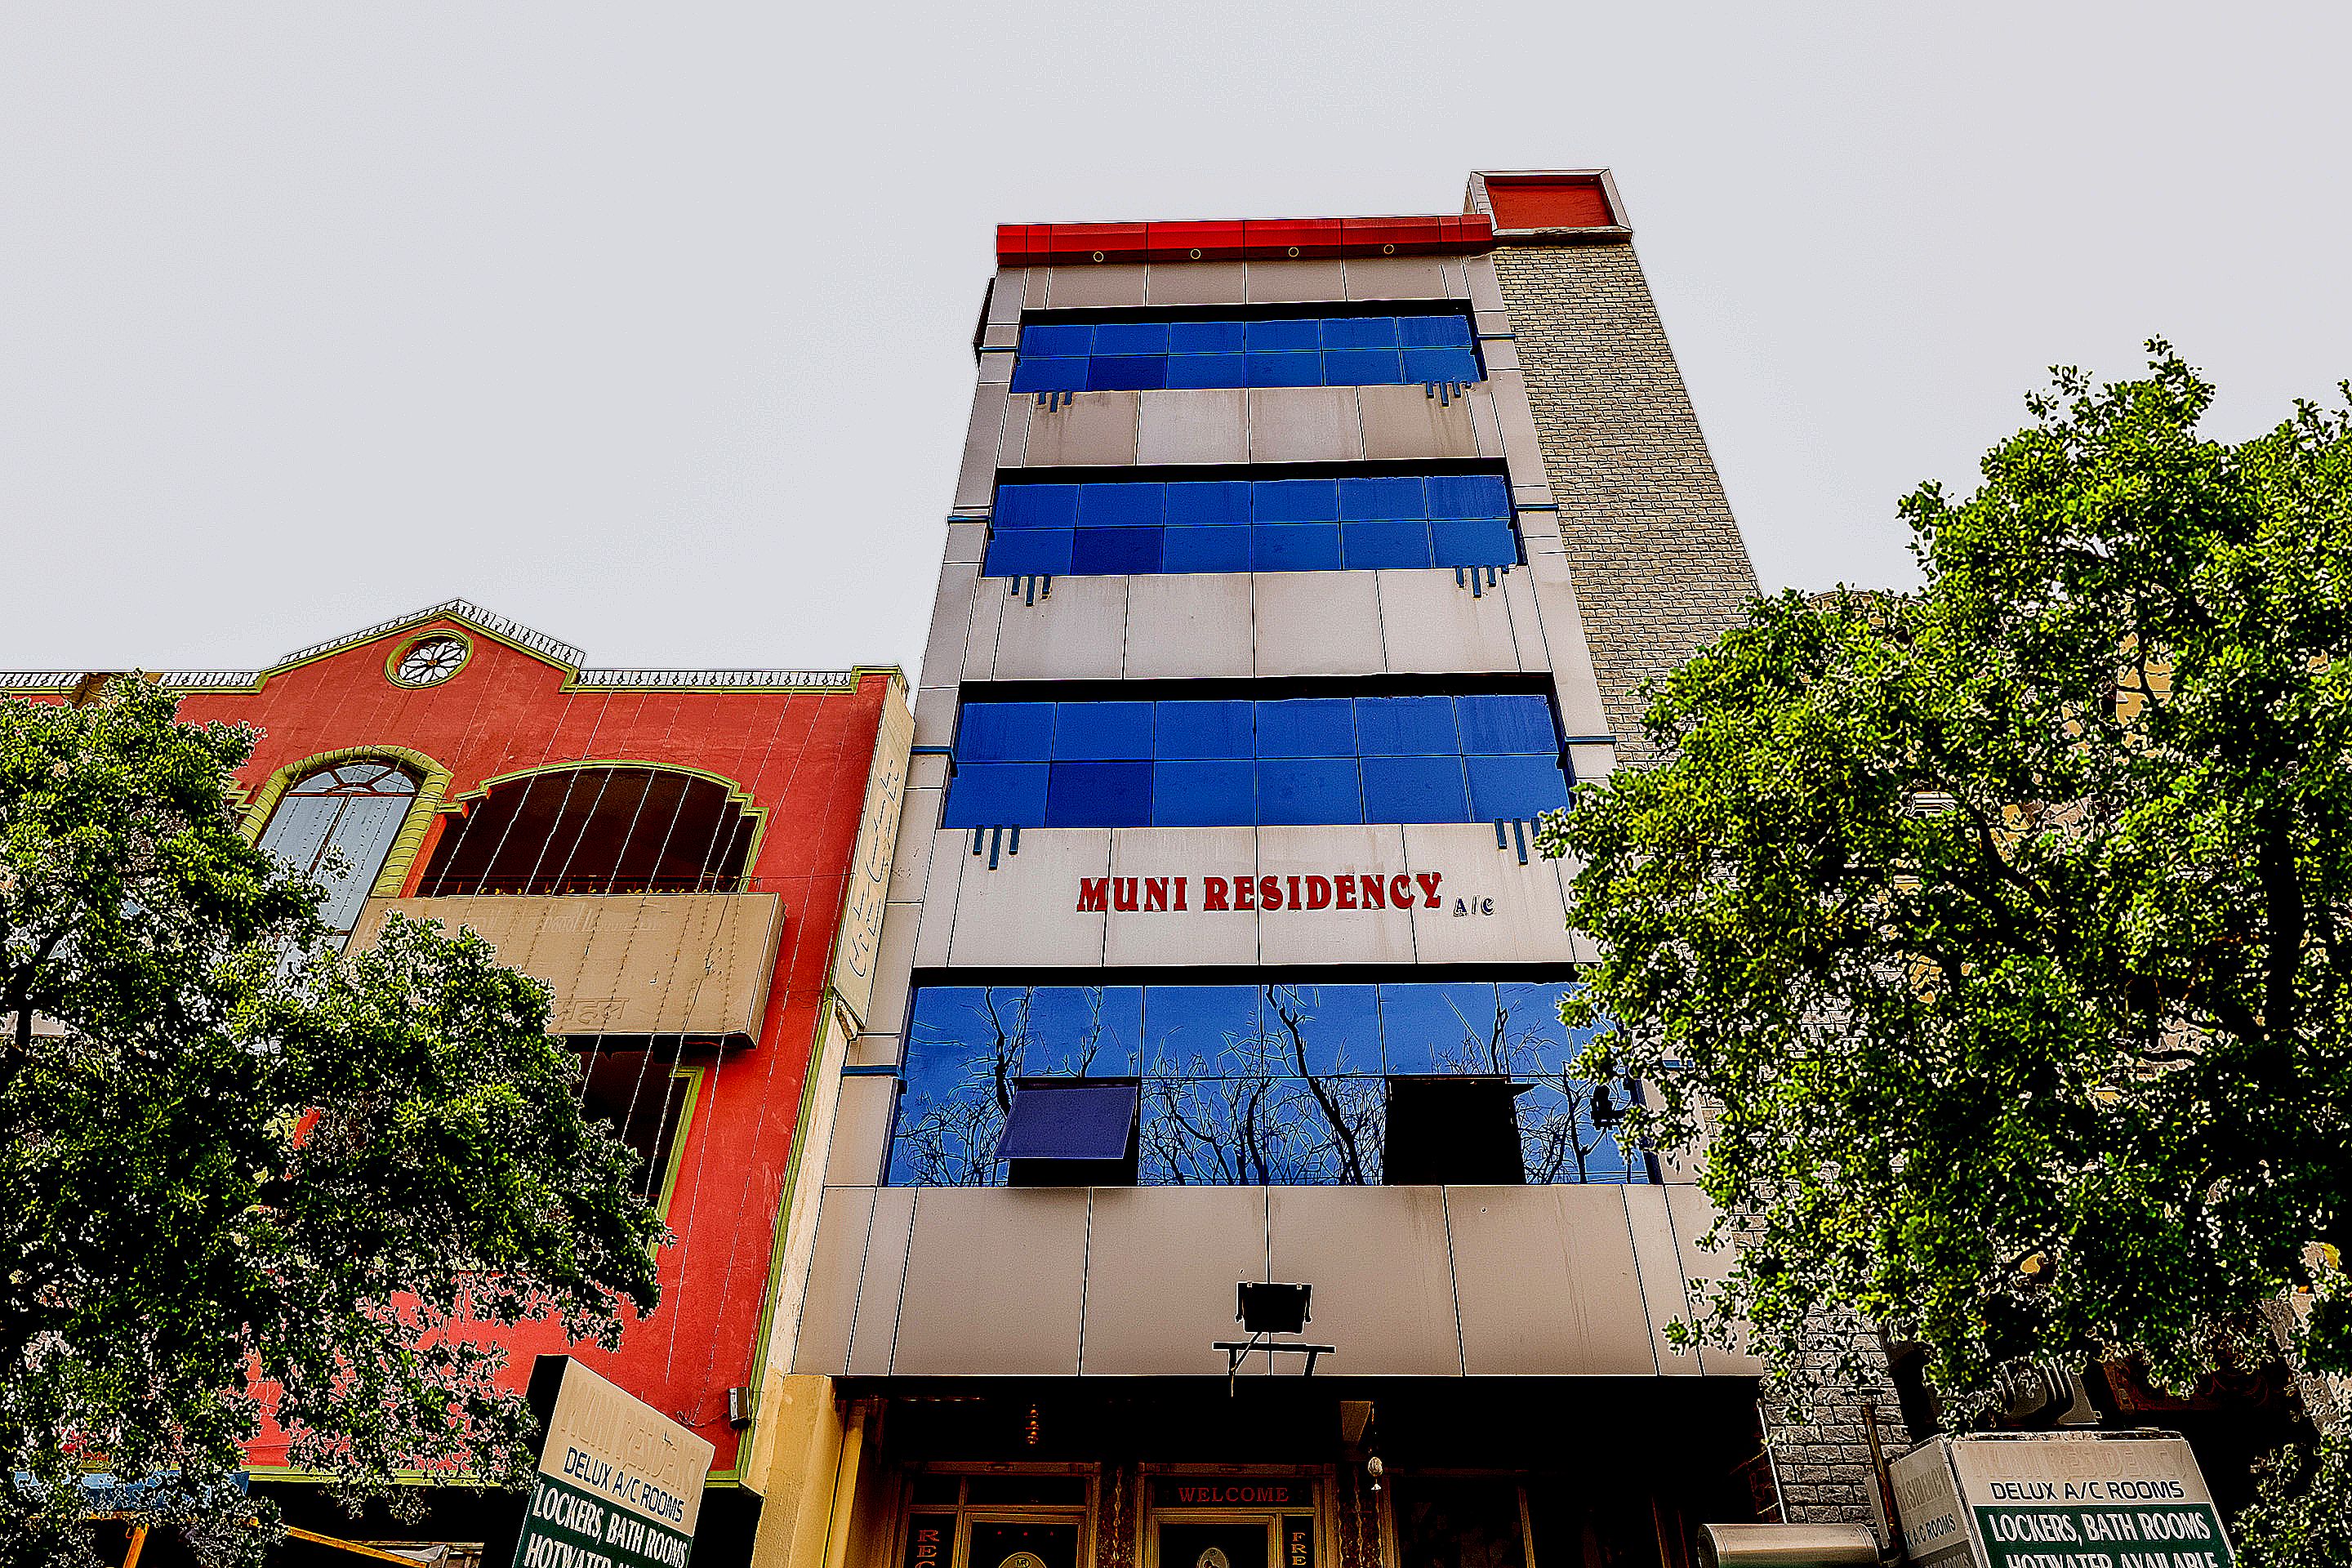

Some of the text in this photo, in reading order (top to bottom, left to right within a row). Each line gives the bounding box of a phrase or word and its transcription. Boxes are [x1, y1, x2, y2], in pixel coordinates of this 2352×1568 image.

[1076, 871, 1444, 912] MUNI RESIDENCY
[1453, 894, 1494, 917] A/C
[563, 1446, 686, 1524] DELUX A/C ROOMS
[1178, 1487, 1290, 1503] WELCOME
[1989, 1481, 2185, 1500] DELUX A/C ROOMS
[532, 1483, 688, 1568] LOCKERS, BATH ROOMS
[1926, 1512, 1957, 1541] ROOMS
[1988, 1512, 2211, 1548] LOCKERS, BATH ROOMS
